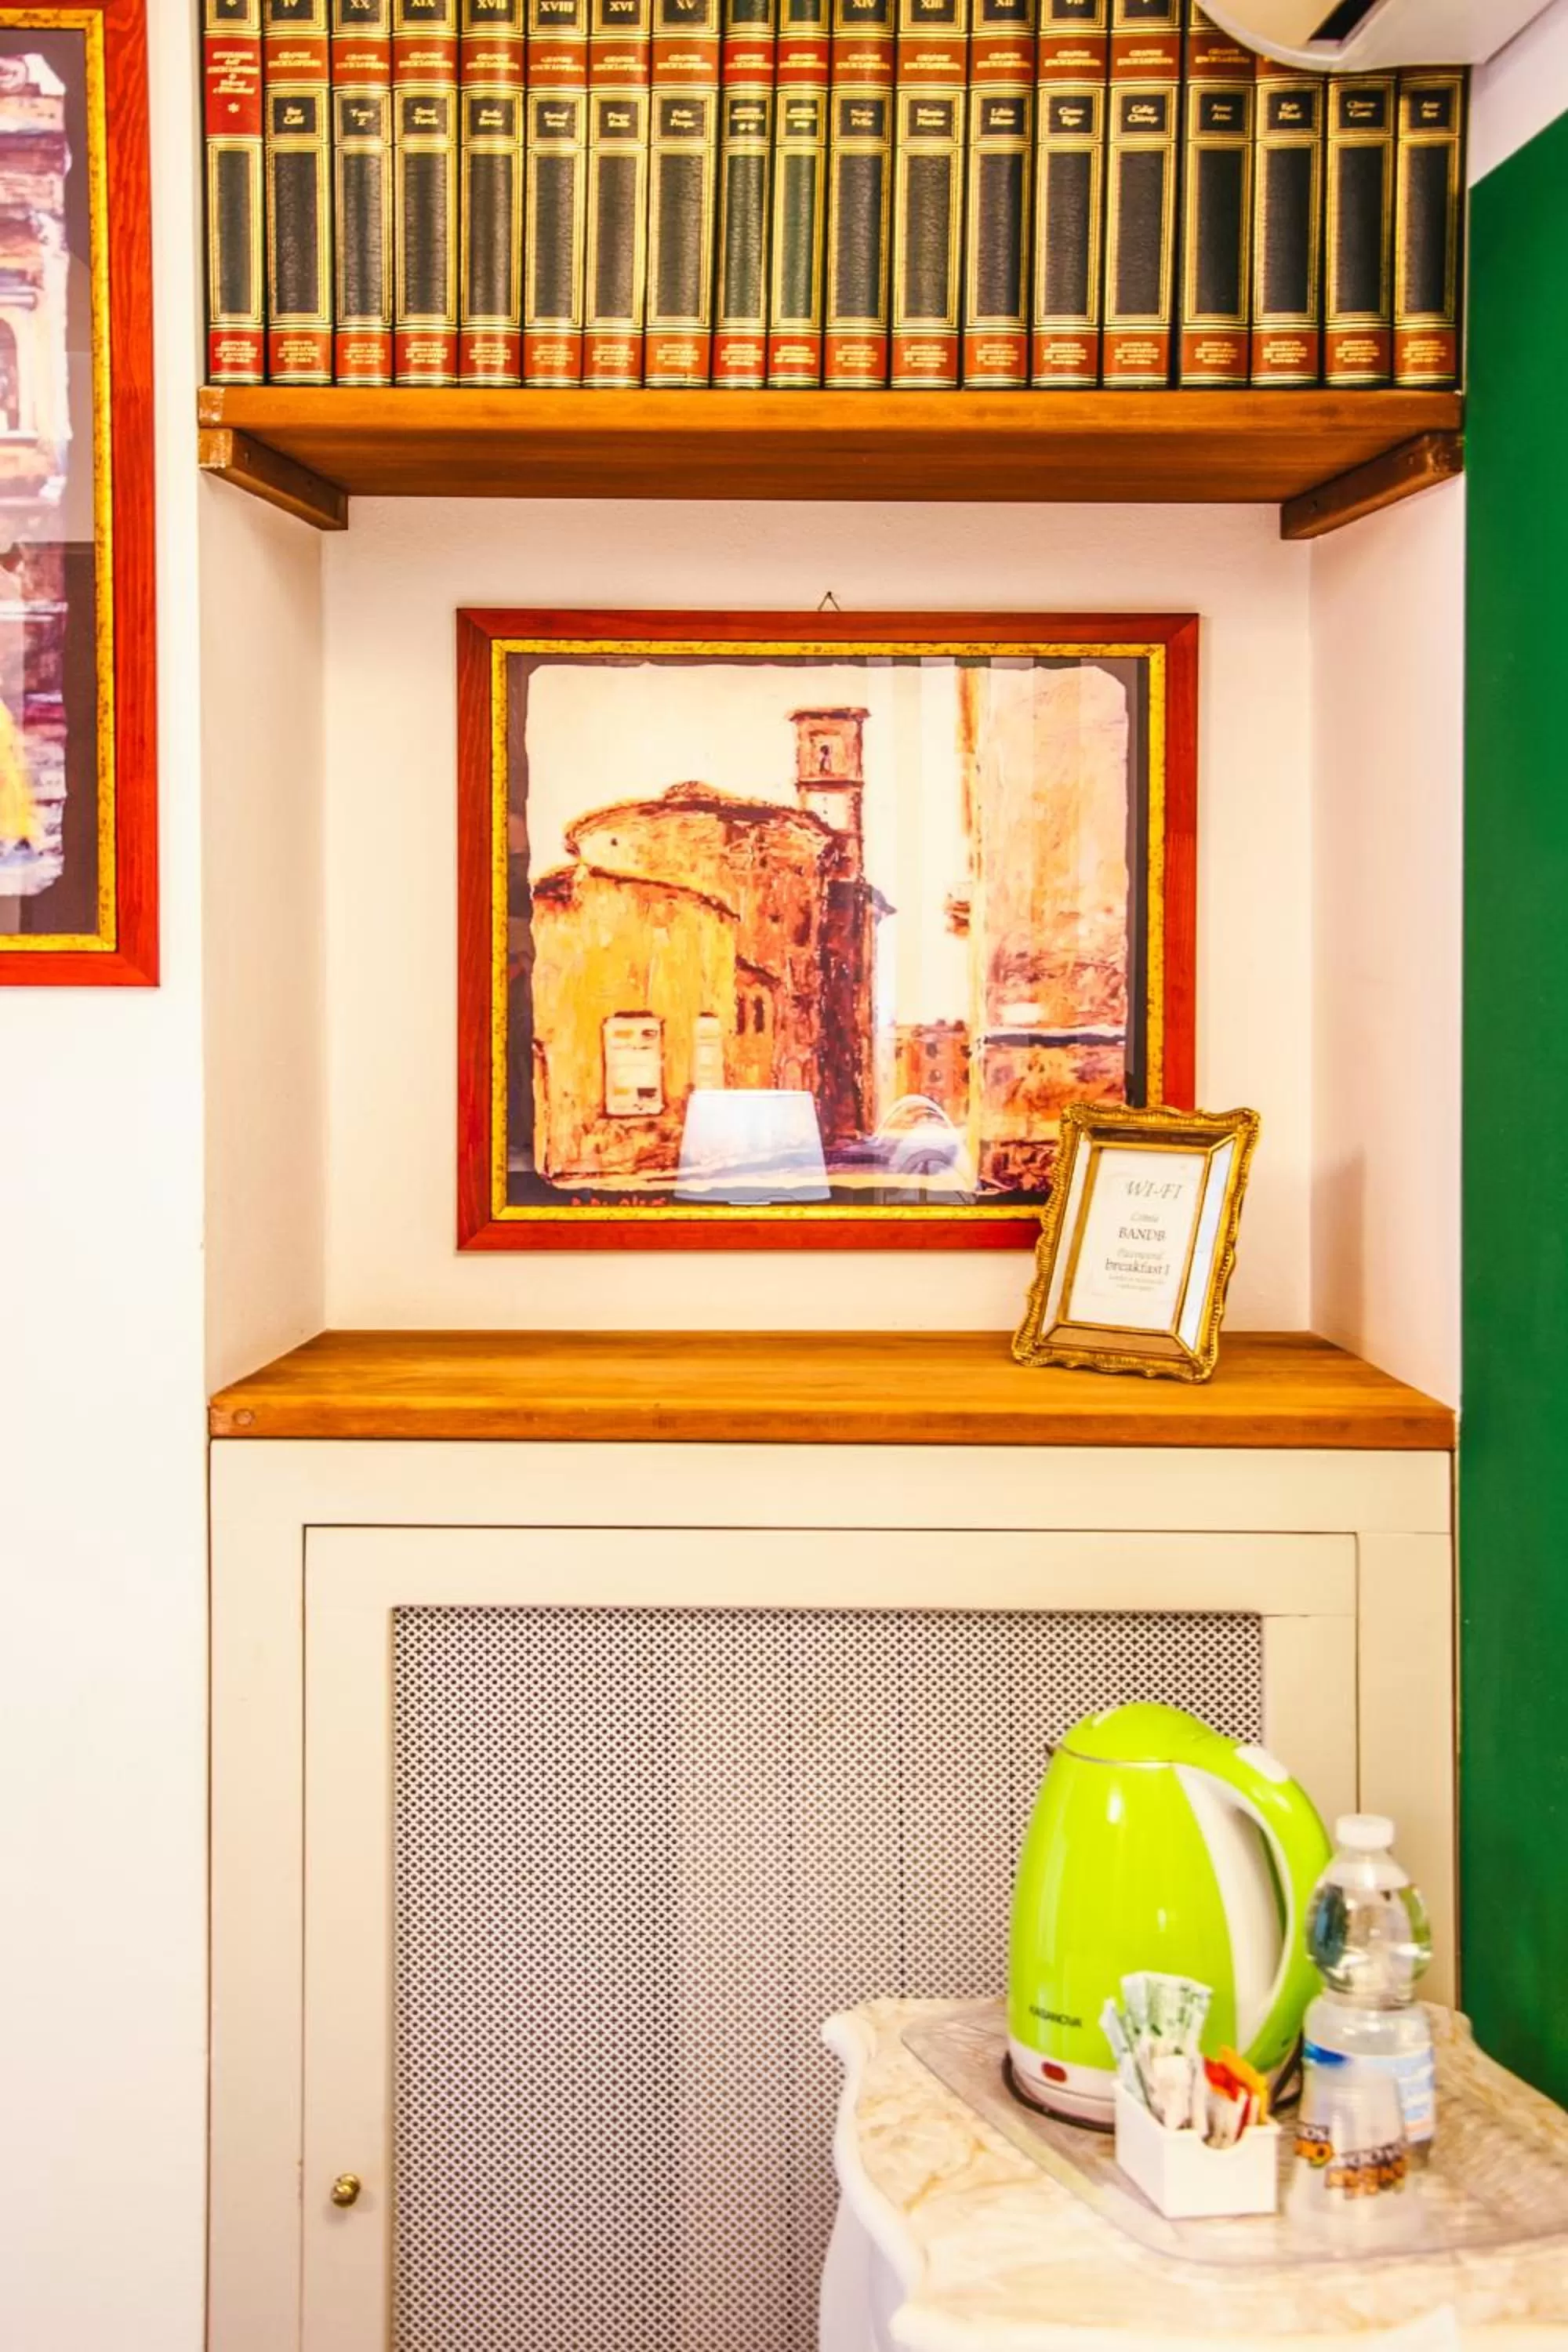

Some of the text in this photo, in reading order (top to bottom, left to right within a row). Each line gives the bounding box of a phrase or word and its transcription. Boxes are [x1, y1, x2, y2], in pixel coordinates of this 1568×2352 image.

[539, 1, 575, 13] XVIII
[609, 1, 635, 12] XVI
[1126, 1179, 1184, 1200] WI-FI
[1118, 1226, 1167, 1242] BANDB
